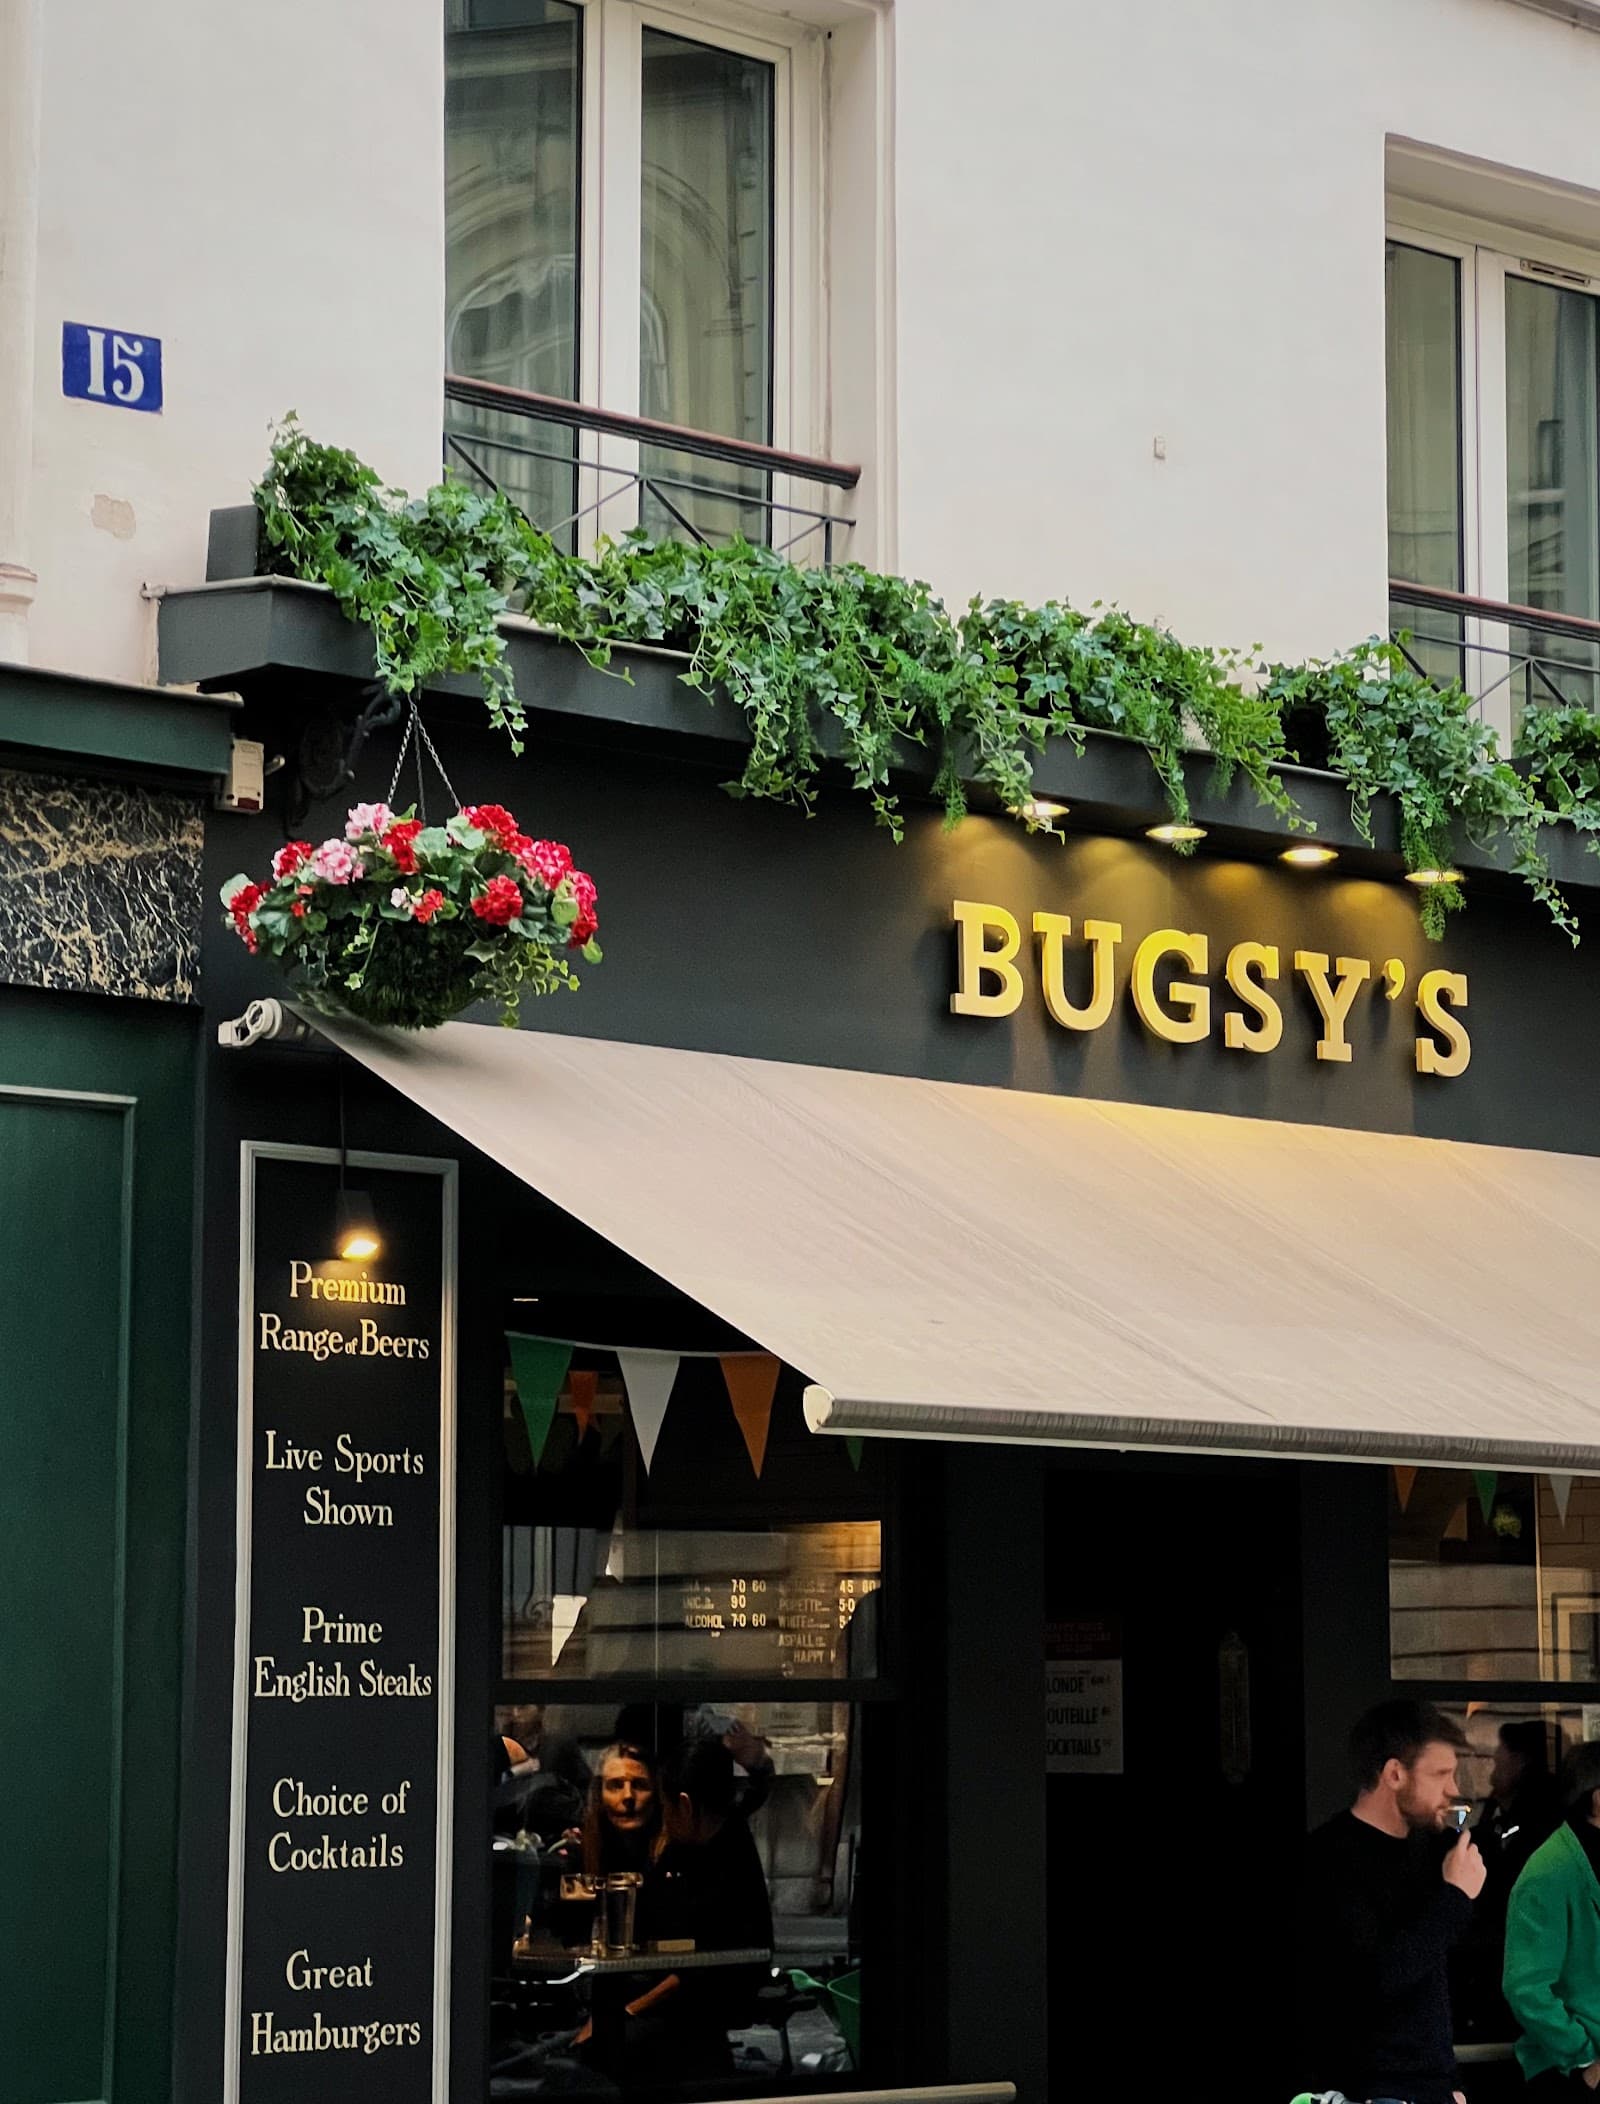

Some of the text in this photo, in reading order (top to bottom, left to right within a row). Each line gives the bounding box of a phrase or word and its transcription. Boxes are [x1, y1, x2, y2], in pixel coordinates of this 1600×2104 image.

[87, 329, 145, 402] 15
[950, 900, 1471, 1077] BUGSY'S
[289, 1260, 406, 1306] Premium
[259, 1313, 430, 1361] Range of Beers
[265, 1430, 425, 1483] Live Sports
[303, 1486, 394, 1527] Shown
[302, 1606, 383, 1644] Prime
[254, 1656, 432, 1703] English Steaks
[1046, 1678, 1084, 1693] LONDE
[1046, 1707, 1098, 1724] OUTEILLE
[1046, 1738, 1101, 1755] OCKTAILS
[272, 1777, 411, 1818] Choice of
[268, 1831, 404, 1873] Cocktails
[286, 1949, 374, 1991] Great
[250, 2011, 421, 2055] Hamburgers
